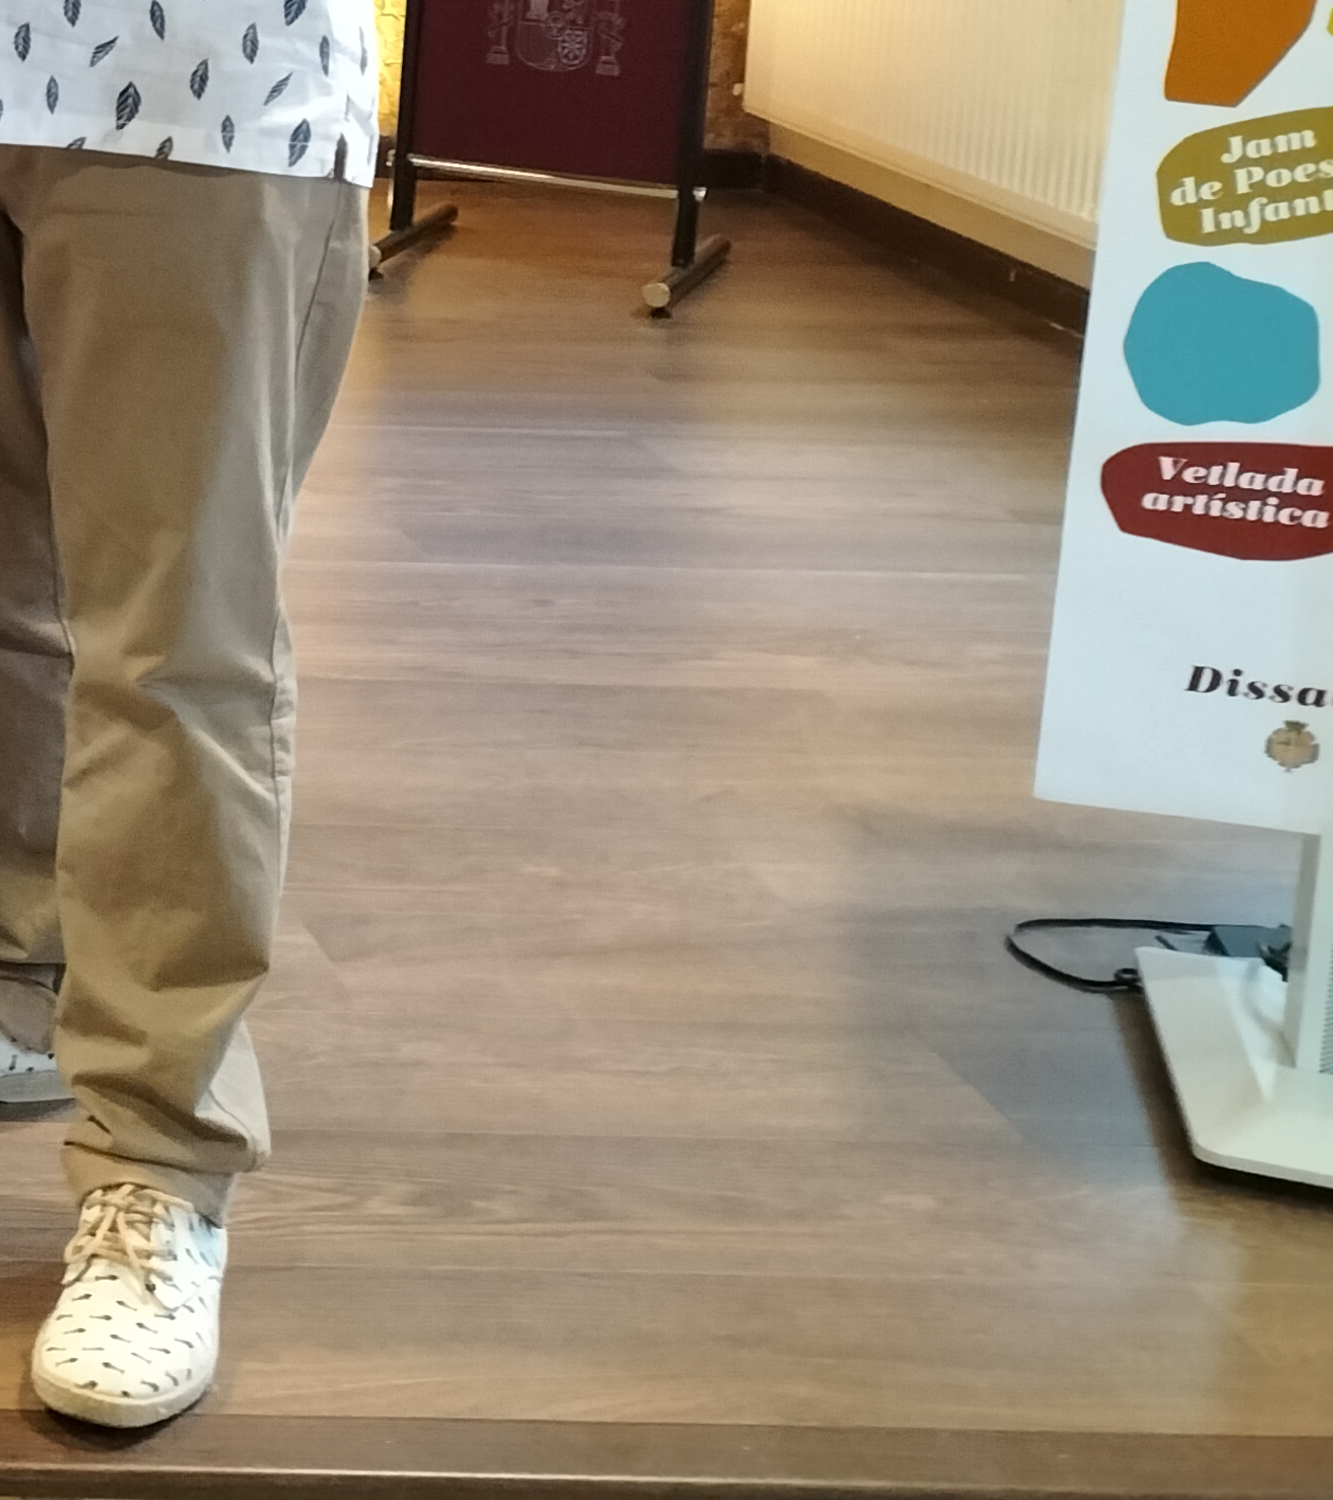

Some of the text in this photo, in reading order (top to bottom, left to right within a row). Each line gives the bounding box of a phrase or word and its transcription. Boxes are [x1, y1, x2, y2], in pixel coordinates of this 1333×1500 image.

[1221, 129, 1317, 164] Jam
[1169, 176, 1223, 206] de
[1158, 456, 1325, 496] Vetlada
[1141, 492, 1330, 529] artística
[1184, 665, 1333, 708] Dissa
